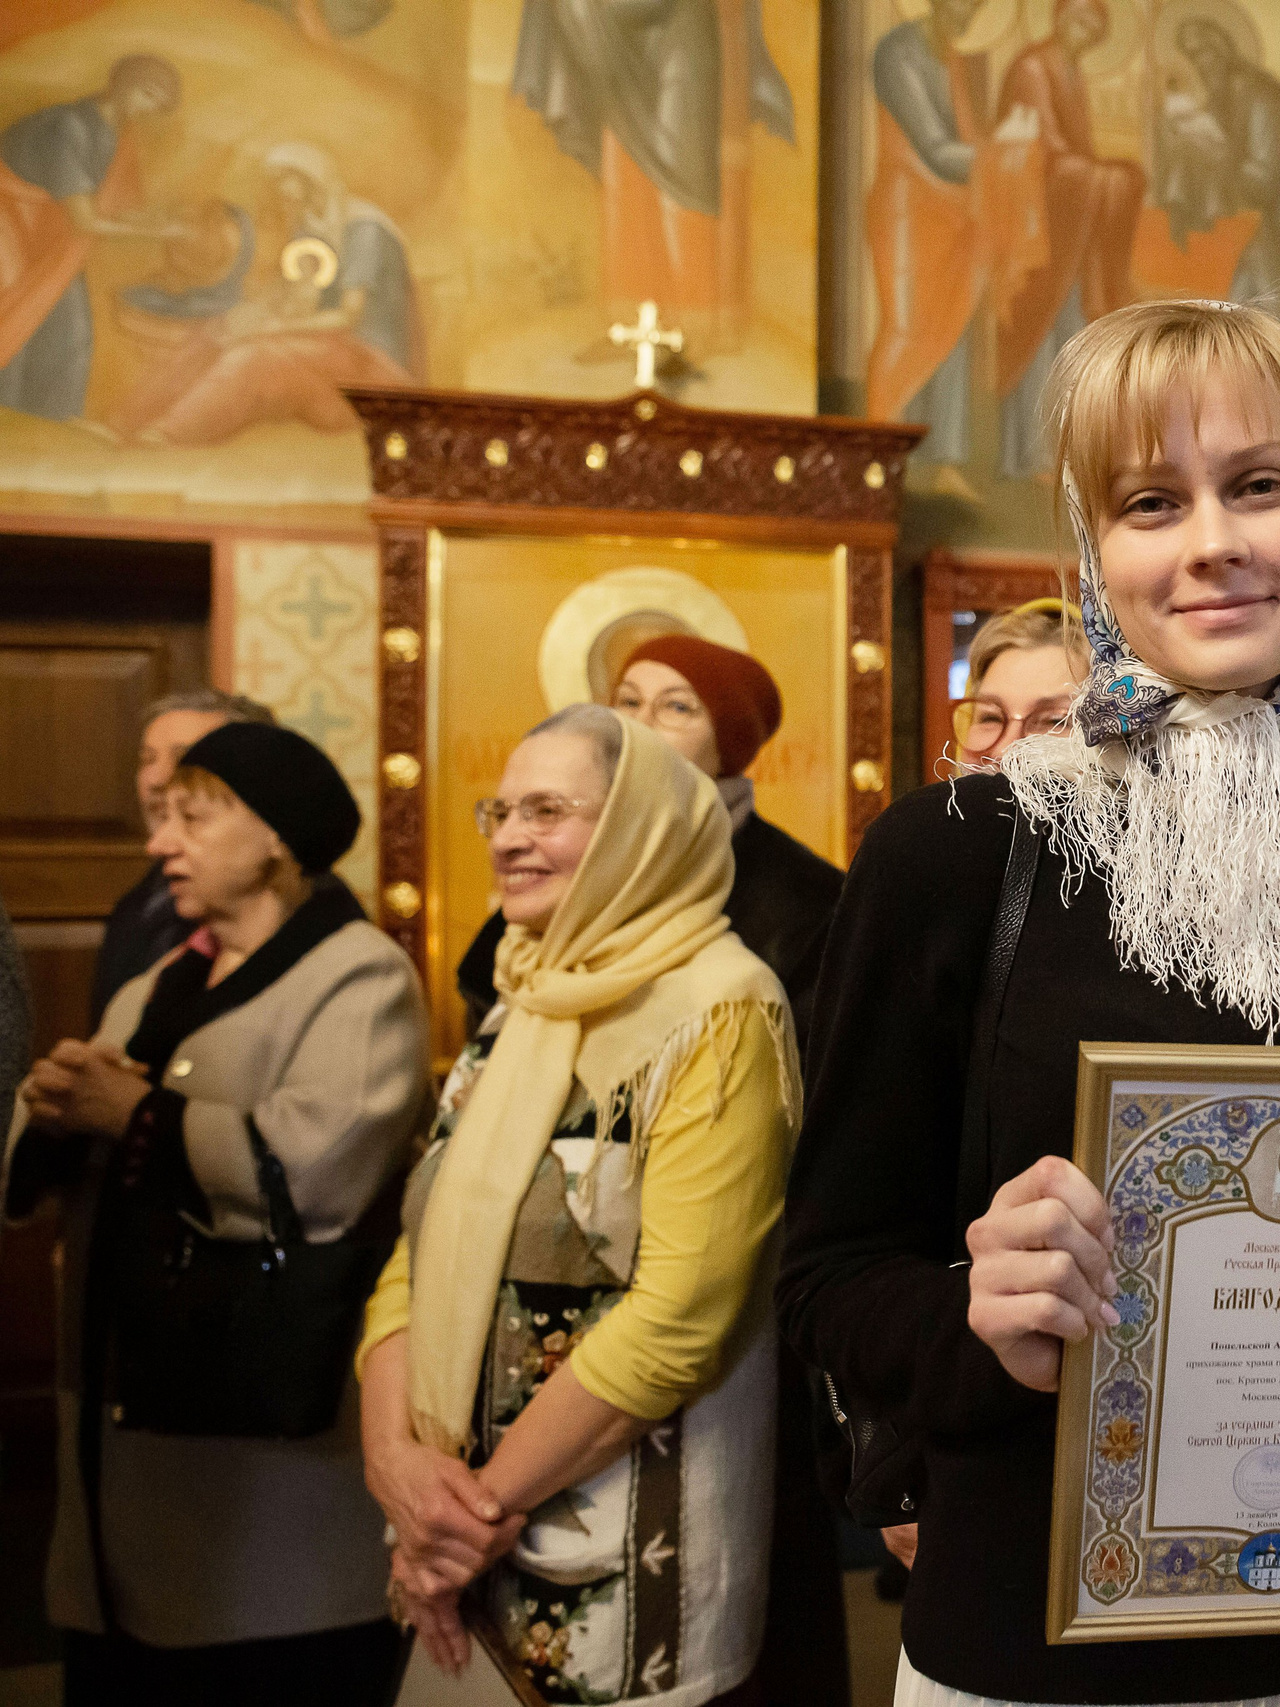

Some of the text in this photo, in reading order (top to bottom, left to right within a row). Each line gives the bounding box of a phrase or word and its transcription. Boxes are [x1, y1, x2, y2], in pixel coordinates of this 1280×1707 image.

[1223, 1258, 1264, 1271] Русская
[1186, 1361, 1243, 1370] прихожанке
[1245, 1360, 1274, 1369] храма
[1238, 1376, 1277, 1386] Кратово
[1231, 1421, 1274, 1434] усердные
[1187, 1435, 1223, 1447] Святой
[1226, 1434, 1261, 1450] Церкви
[1235, 1511, 1245, 1519] 13
[1247, 1511, 1278, 1519] декабря
